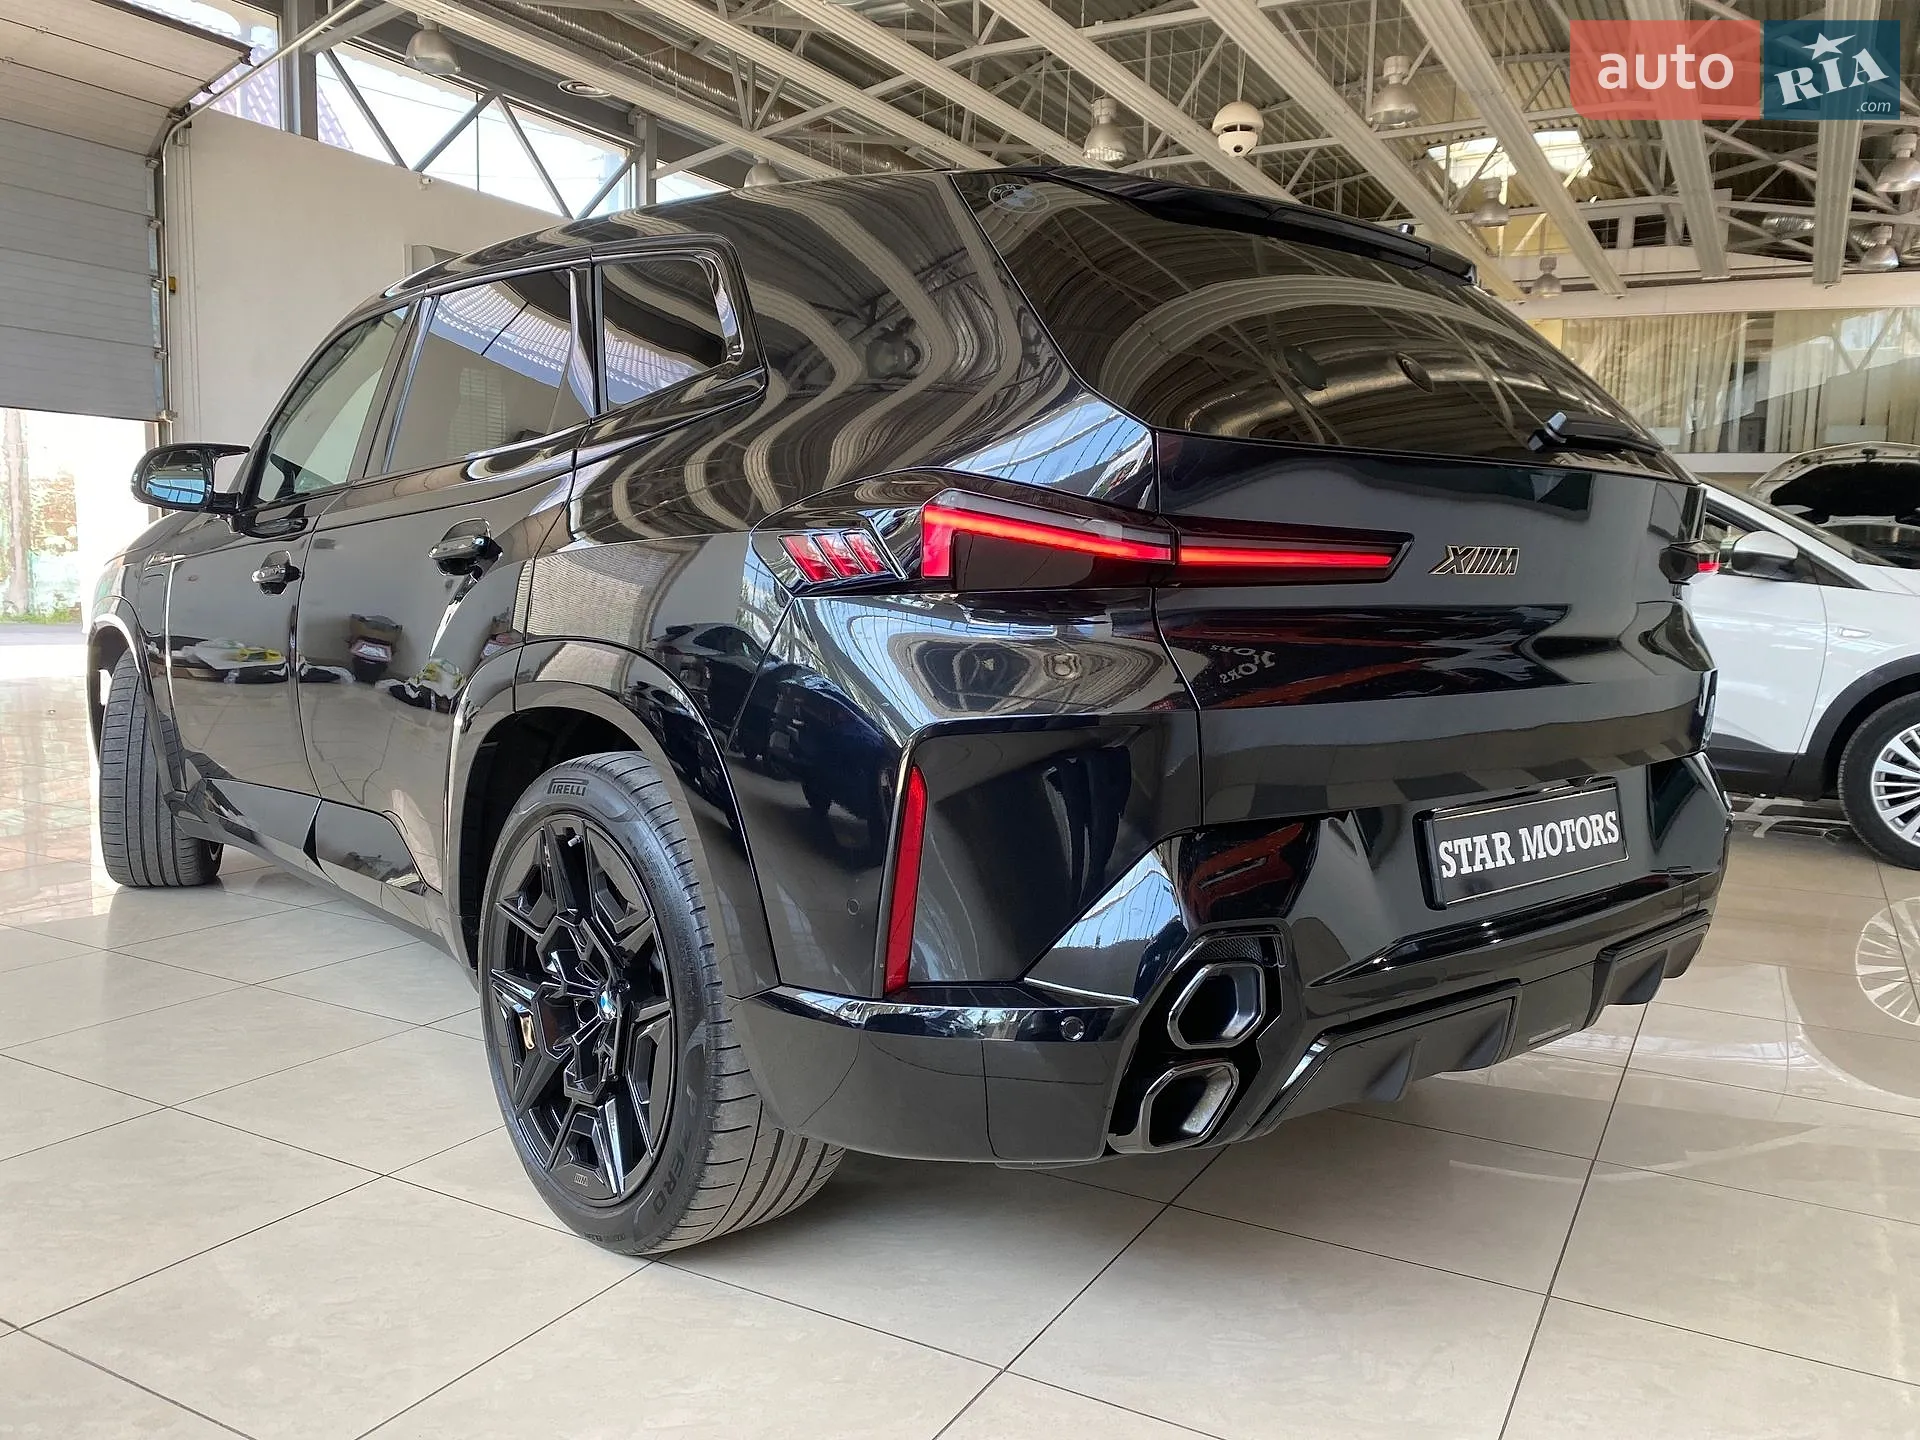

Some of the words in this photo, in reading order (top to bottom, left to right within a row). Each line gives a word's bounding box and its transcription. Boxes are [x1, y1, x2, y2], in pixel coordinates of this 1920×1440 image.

[547, 777, 589, 797] PIRELLI
[1438, 831, 1516, 879] STAR
[1518, 810, 1620, 863] MOTORS
